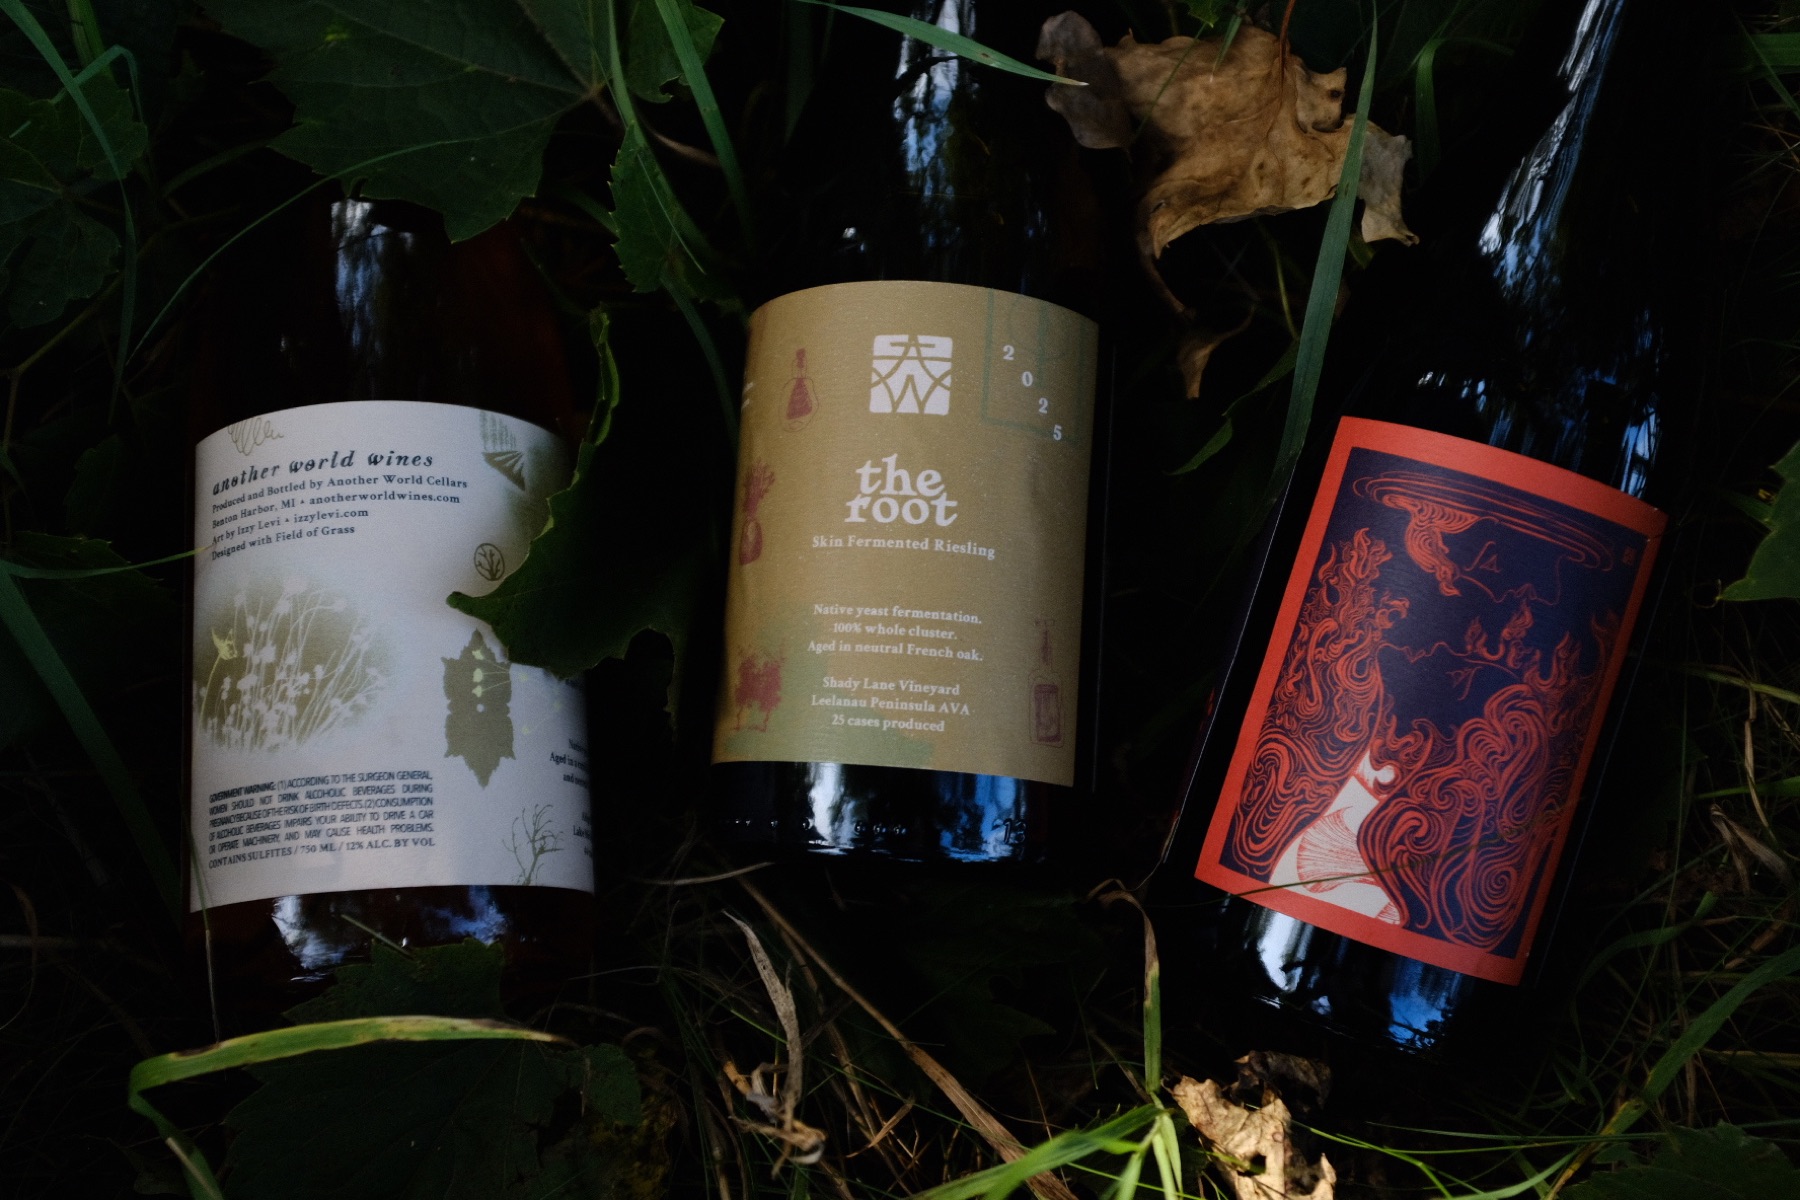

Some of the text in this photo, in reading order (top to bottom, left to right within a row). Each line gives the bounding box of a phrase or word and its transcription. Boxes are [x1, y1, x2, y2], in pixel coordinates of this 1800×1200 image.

[212, 450, 433, 495] another world wines
[856, 453, 945, 497] the
[212, 474, 468, 513] Produced and Bottled by Another World Cellars
[844, 492, 958, 527] root
[212, 491, 460, 529] Benton Harbor, MI anotherworldwines.com
[212, 508, 369, 546] Art by Izzy Levi izzylevi.com
[212, 525, 355, 561] Designed with Field of Grass
[812, 535, 996, 560] Skin Fermented Riesling
[813, 604, 982, 624] Native yeast fermentation.
[833, 622, 958, 640] 100% whole cluster.
[807, 640, 983, 661] Aged in neutral French oak.
[822, 677, 960, 696] Shady Lane Vineyard
[811, 695, 970, 716] Leelanau Peninsula AVA
[832, 714, 945, 732] 25 cases produced
[209, 786, 244, 803] GOVERNMENT
[287, 775, 329, 788] ACCORDING
[331, 774, 340, 784] TO
[342, 773, 356, 783] THE
[358, 771, 395, 782] SURGEON
[209, 783, 433, 816] WOMEN SHOULD NOT DRINK ALCOHOLIC BEVERAGES DURING
[209, 810, 434, 842] OF ALCOHOLIC BEVERAGES IMPAIRS YOUR ABILITY TO DRIVE A CAR
[236, 810, 261, 823] BECAUSE
[270, 806, 284, 817] THE
[284, 804, 300, 816] RISK
[300, 803, 309, 814] OF
[310, 801, 331, 813] BIRTH
[364, 799, 375, 810] (2)
[375, 797, 433, 808] CONSUMPTION
[208, 852, 246, 869] CONTAINS
[247, 846, 292, 861] SULFITES
[300, 844, 316, 854] 750
[319, 842, 337, 853] ML
[346, 841, 364, 851] 12%
[366, 839, 392, 849] ALC.
[394, 838, 409, 848] BY
[412, 837, 435, 847] VOL
[209, 845, 216, 855] OR
[218, 839, 239, 853] OPERATE
[284, 831, 300, 841] AND
[304, 829, 321, 839] MAY
[326, 826, 351, 838] CAUSE
[356, 824, 385, 835] HEALTH
